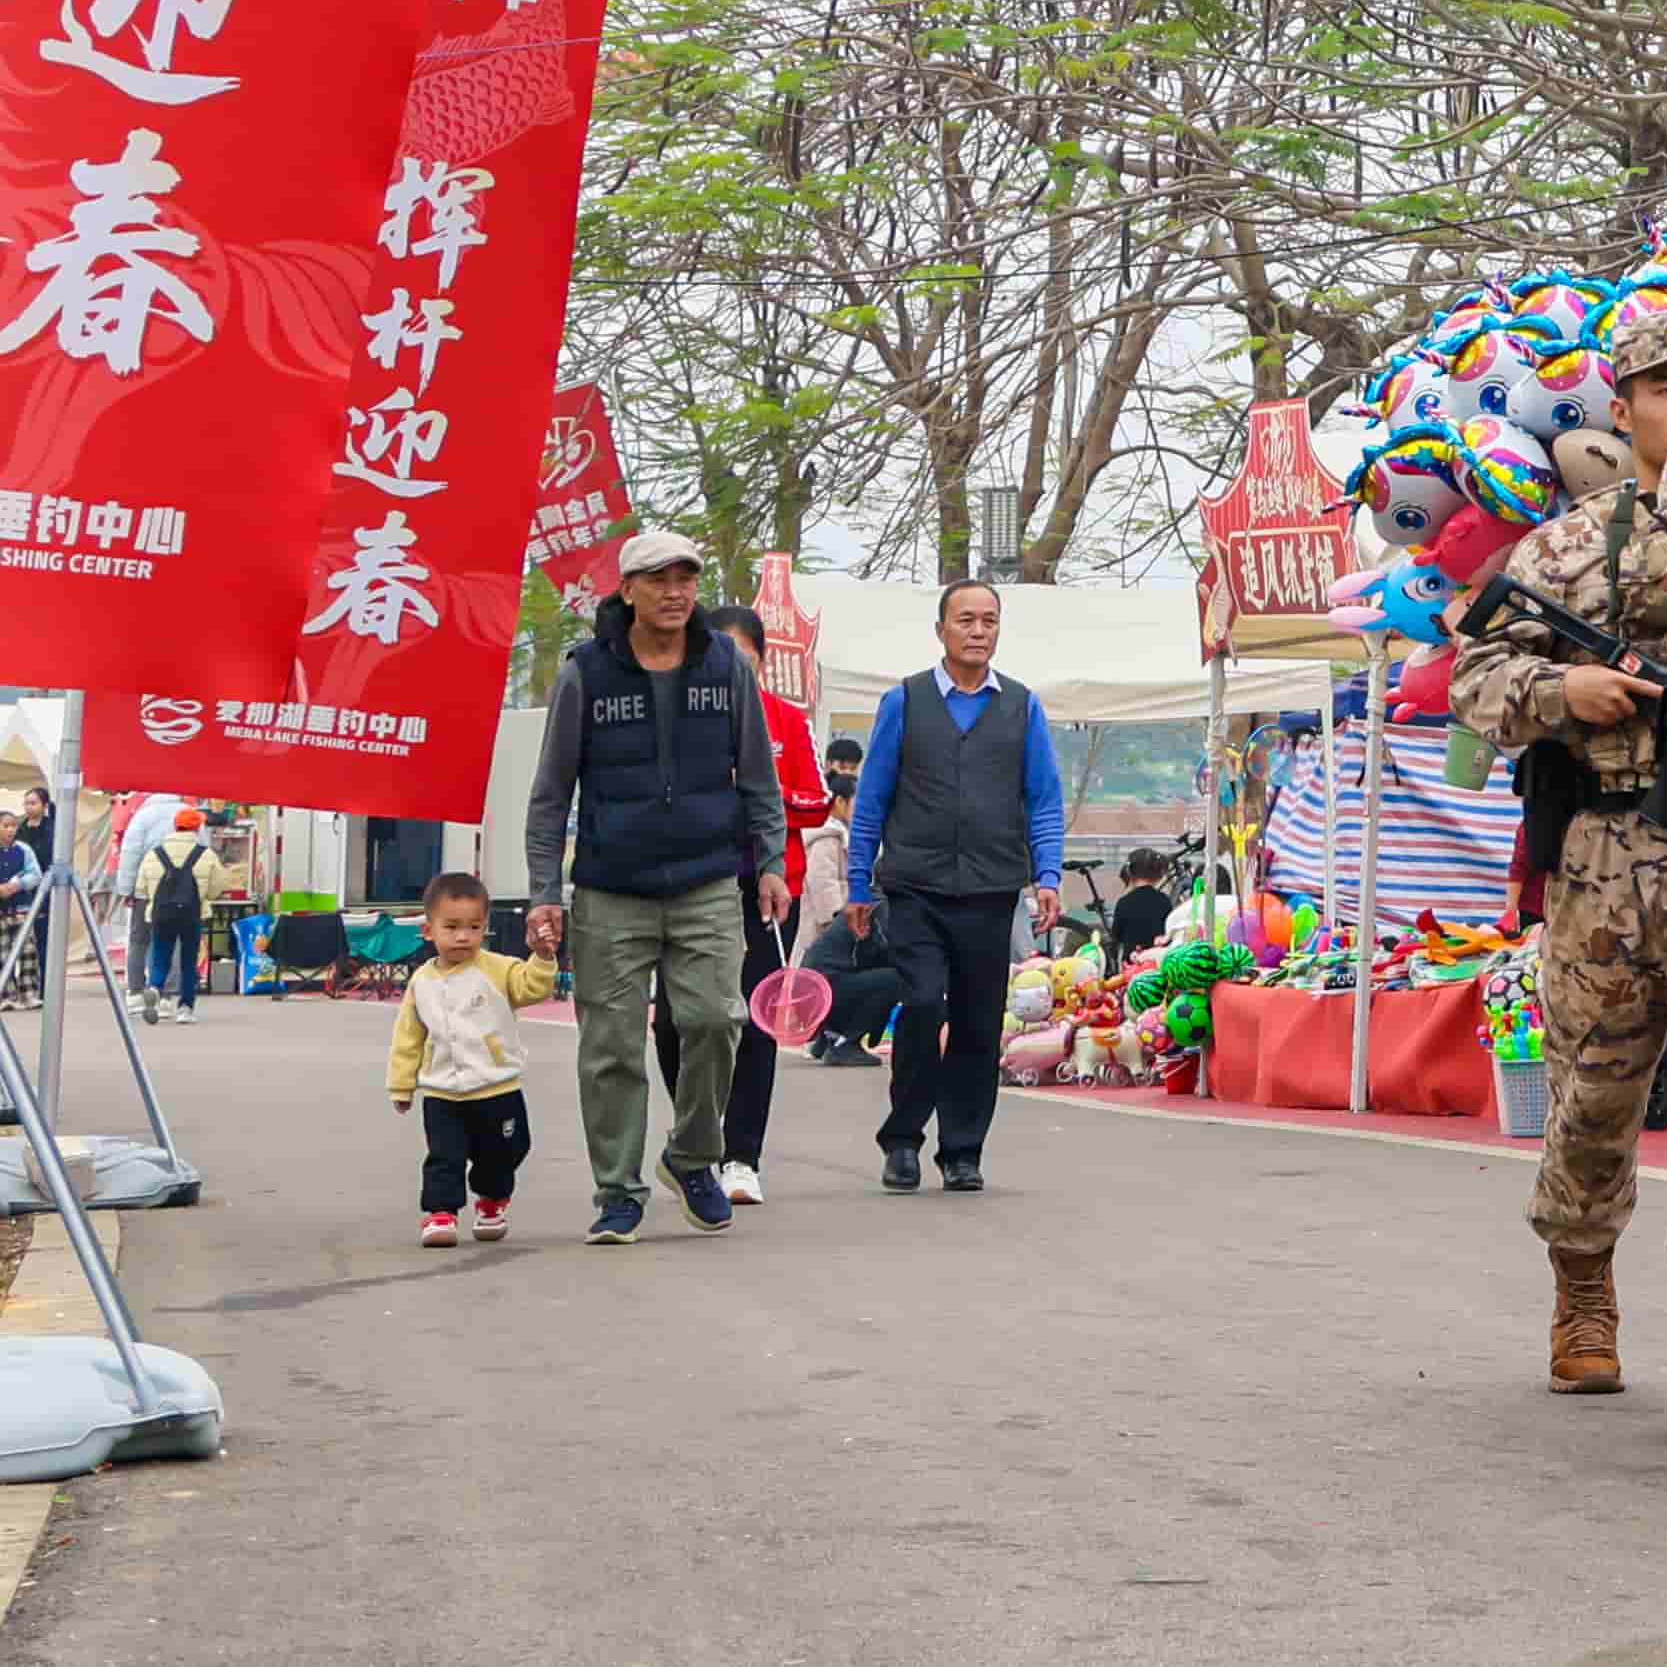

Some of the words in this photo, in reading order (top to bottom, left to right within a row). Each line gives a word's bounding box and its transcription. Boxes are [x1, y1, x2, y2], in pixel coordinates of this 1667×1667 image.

[302, 157, 496, 647] 挥杆迎春
[0, 489, 187, 555] 垂钓中心
[69, 553, 154, 579] CENTER
[593, 694, 645, 723] CHEE
[265, 729, 300, 745] LAKE
[302, 734, 356, 751] FISHING
[359, 740, 410, 757] CENTER
